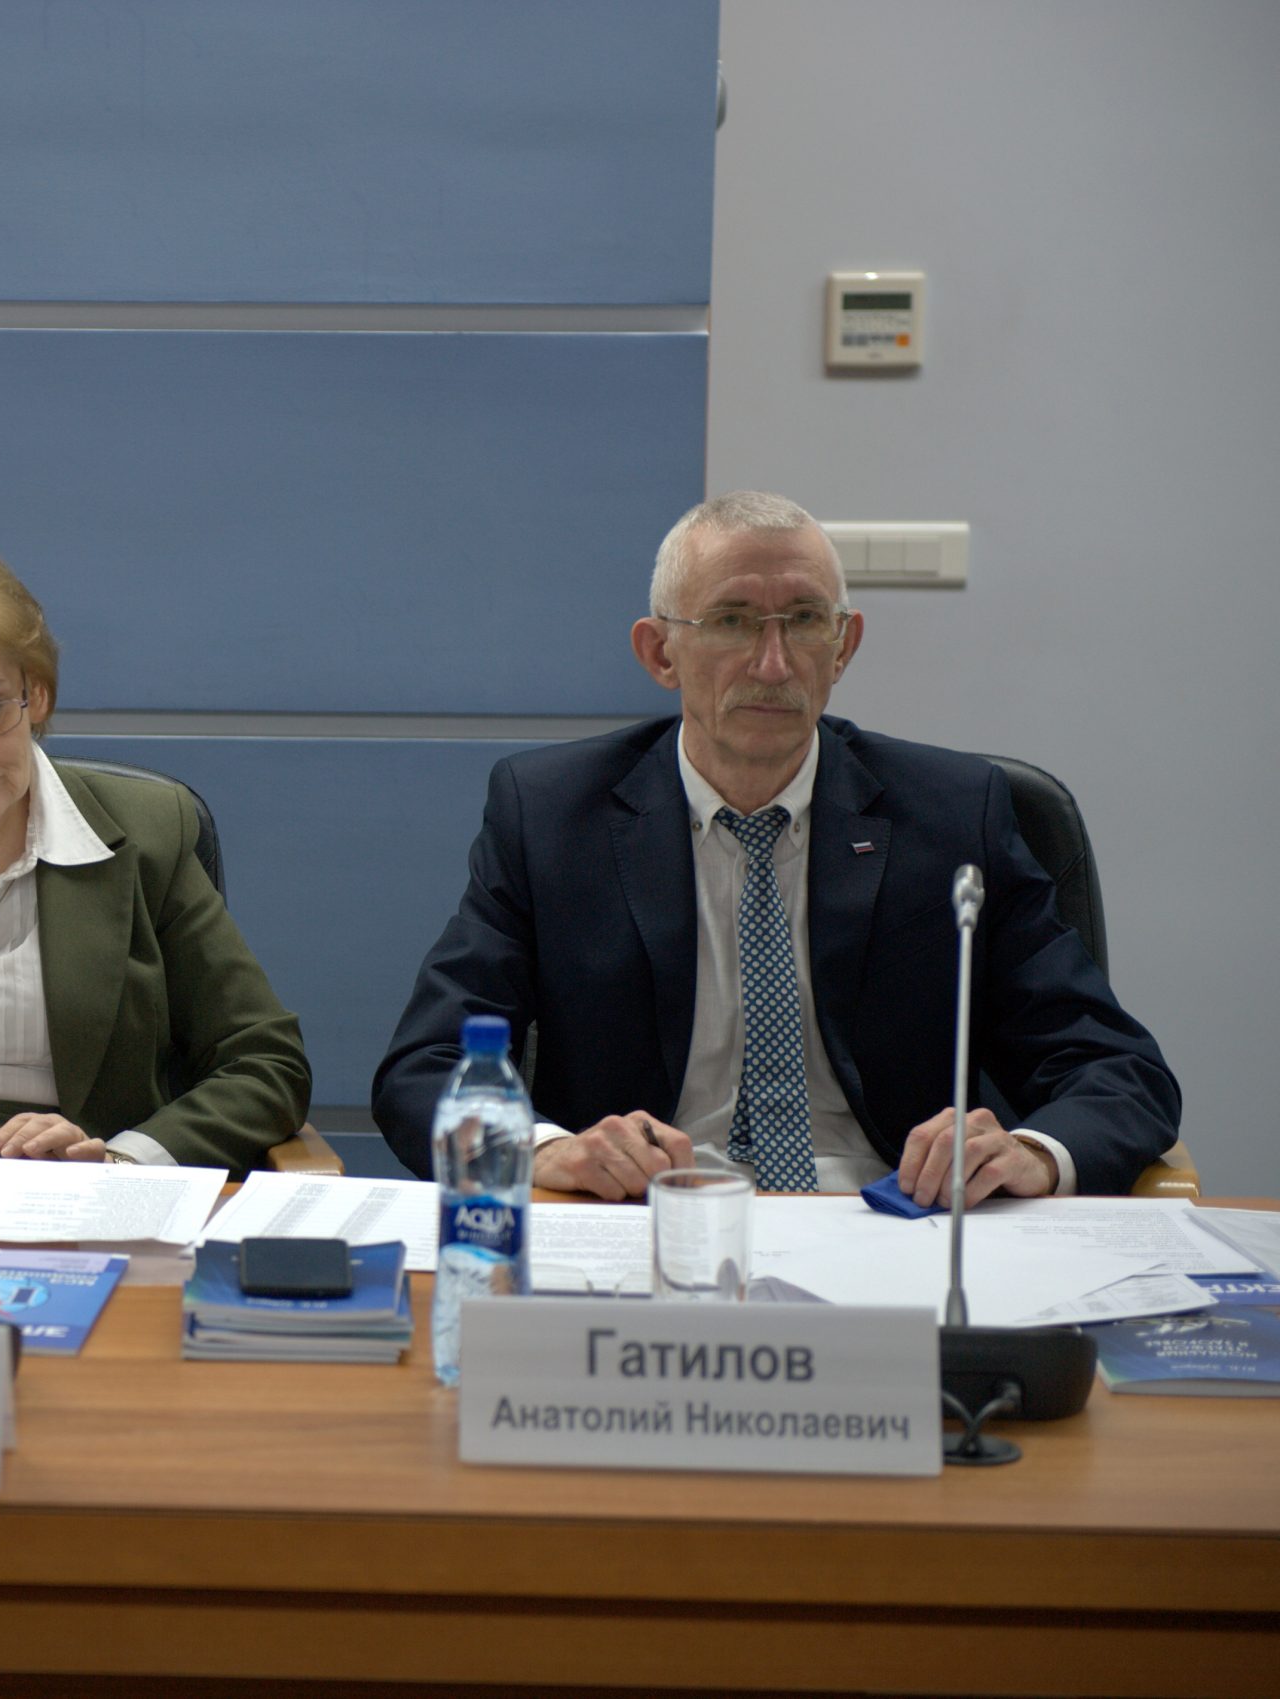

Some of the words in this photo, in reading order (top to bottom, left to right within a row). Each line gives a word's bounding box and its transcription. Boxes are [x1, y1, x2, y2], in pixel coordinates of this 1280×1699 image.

[455, 1205, 515, 1233] AQUA
[586, 1328, 815, 1383] Гатилов
[492, 1396, 672, 1433] Анатолий
[686, 1402, 910, 1441] Николаевич
